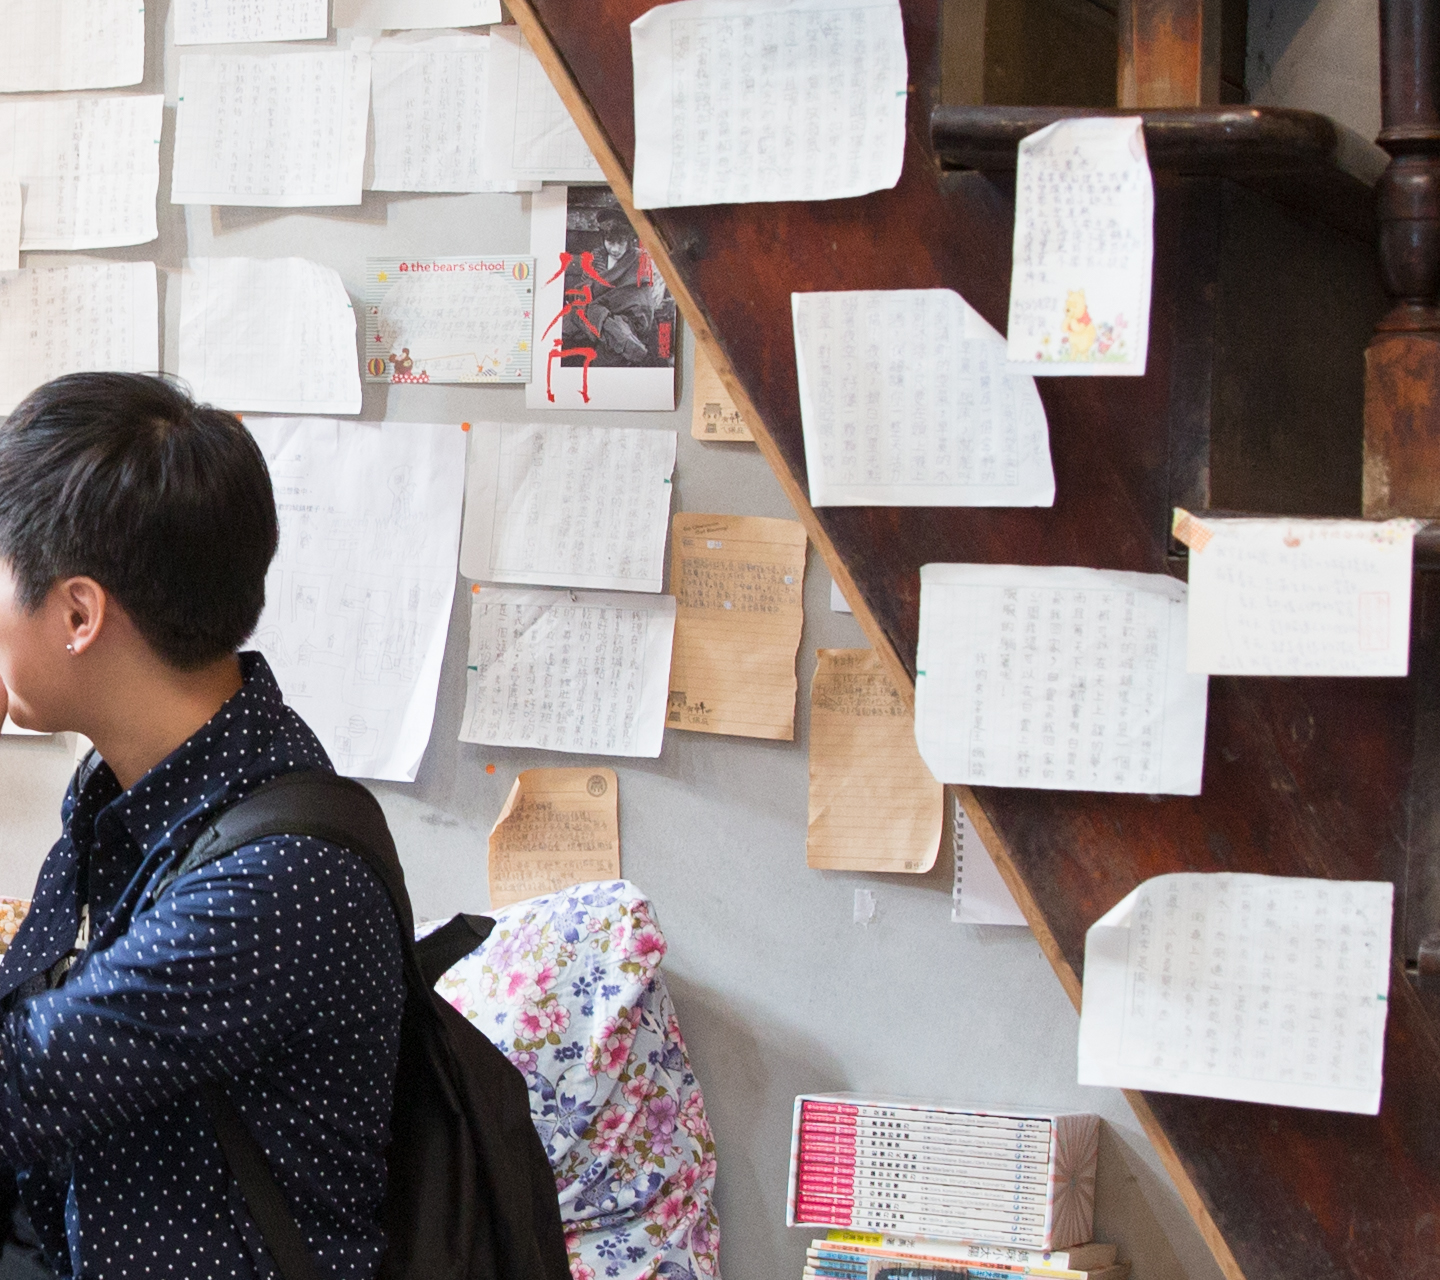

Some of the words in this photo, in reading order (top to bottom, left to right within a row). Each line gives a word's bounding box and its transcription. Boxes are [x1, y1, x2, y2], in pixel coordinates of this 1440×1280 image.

[411, 261, 431, 272] the
[468, 259, 505, 272] school
[541, 249, 616, 404] 八尺門
[967, 1245, 1030, 1265] 媽咪小太陽
